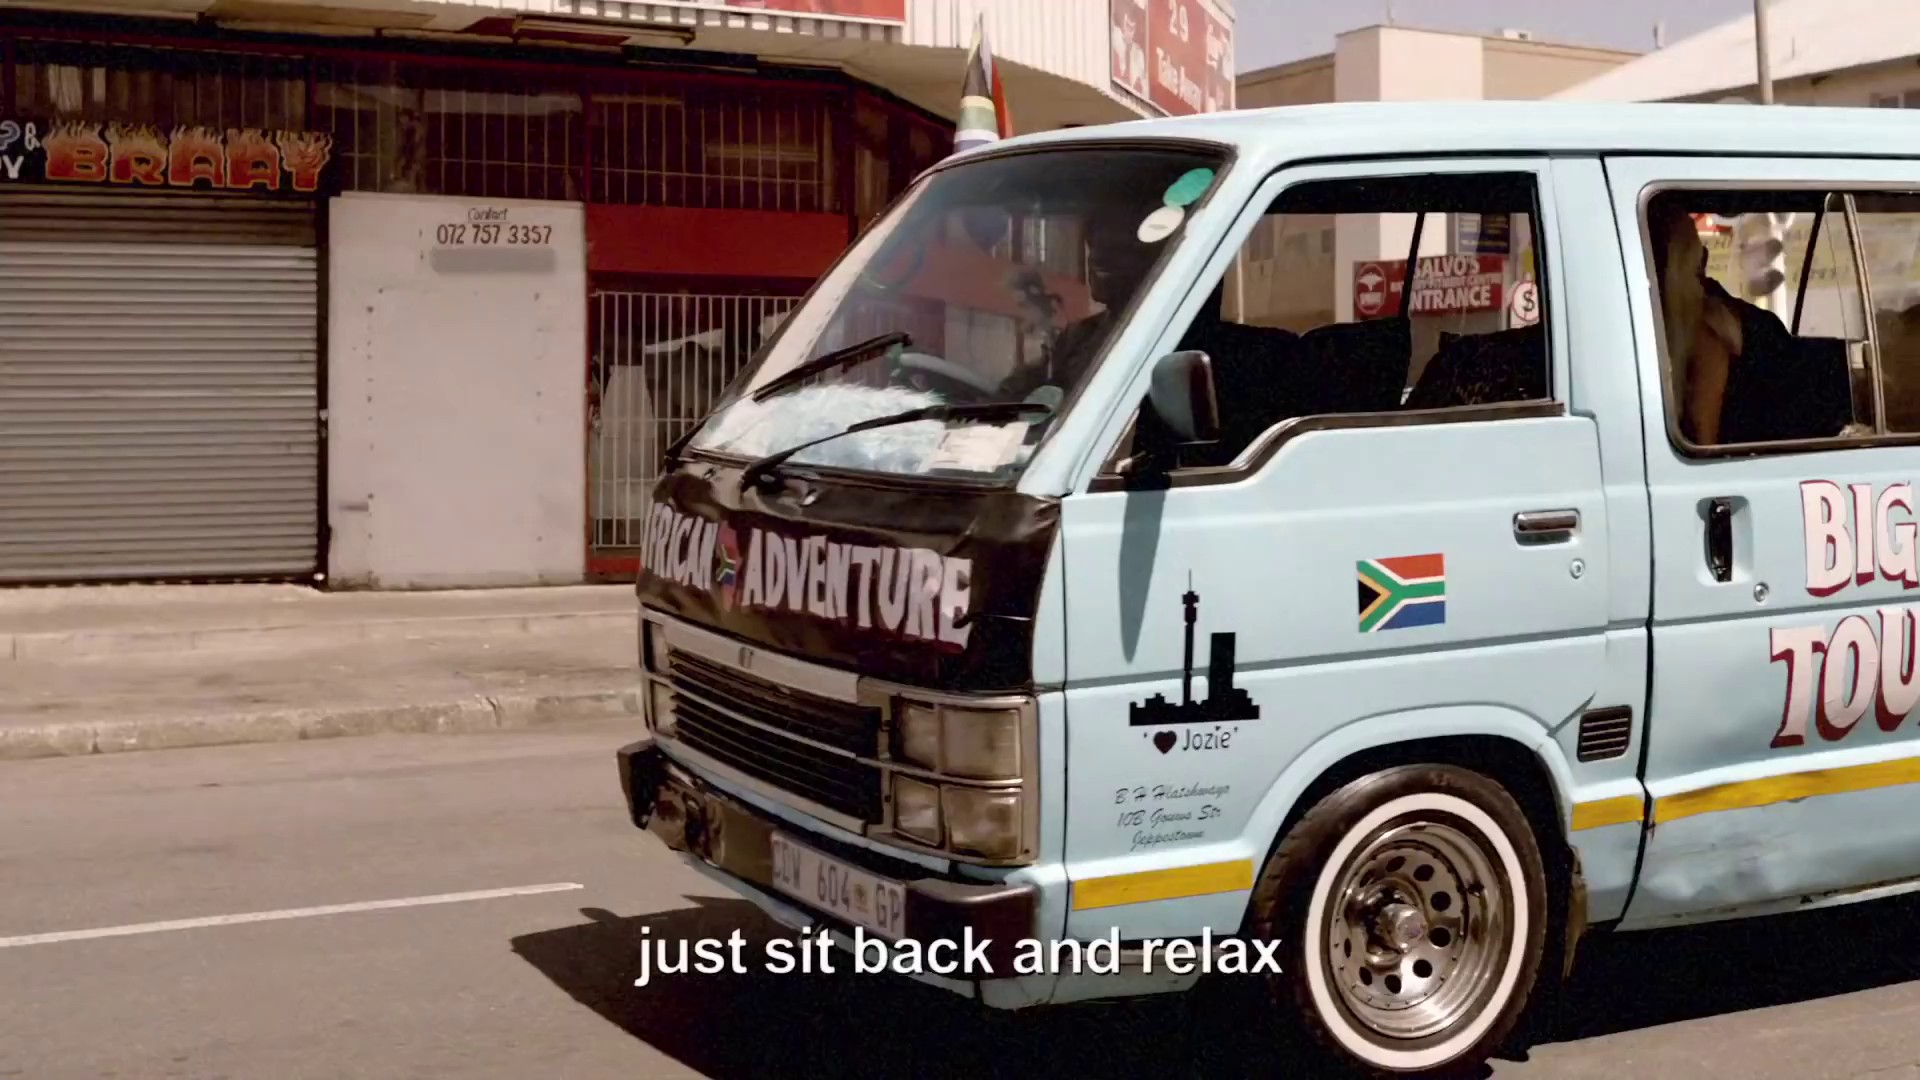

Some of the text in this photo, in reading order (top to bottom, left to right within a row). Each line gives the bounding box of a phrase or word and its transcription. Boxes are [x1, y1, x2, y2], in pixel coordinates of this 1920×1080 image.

[436, 223, 552, 245] 072 757 3357
[1410, 285, 1491, 311] NTRANCE
[1799, 479, 1920, 598] BIG
[742, 527, 973, 650] ADVENTURE
[816, 859, 850, 913] 604
[875, 882, 901, 933] GP
